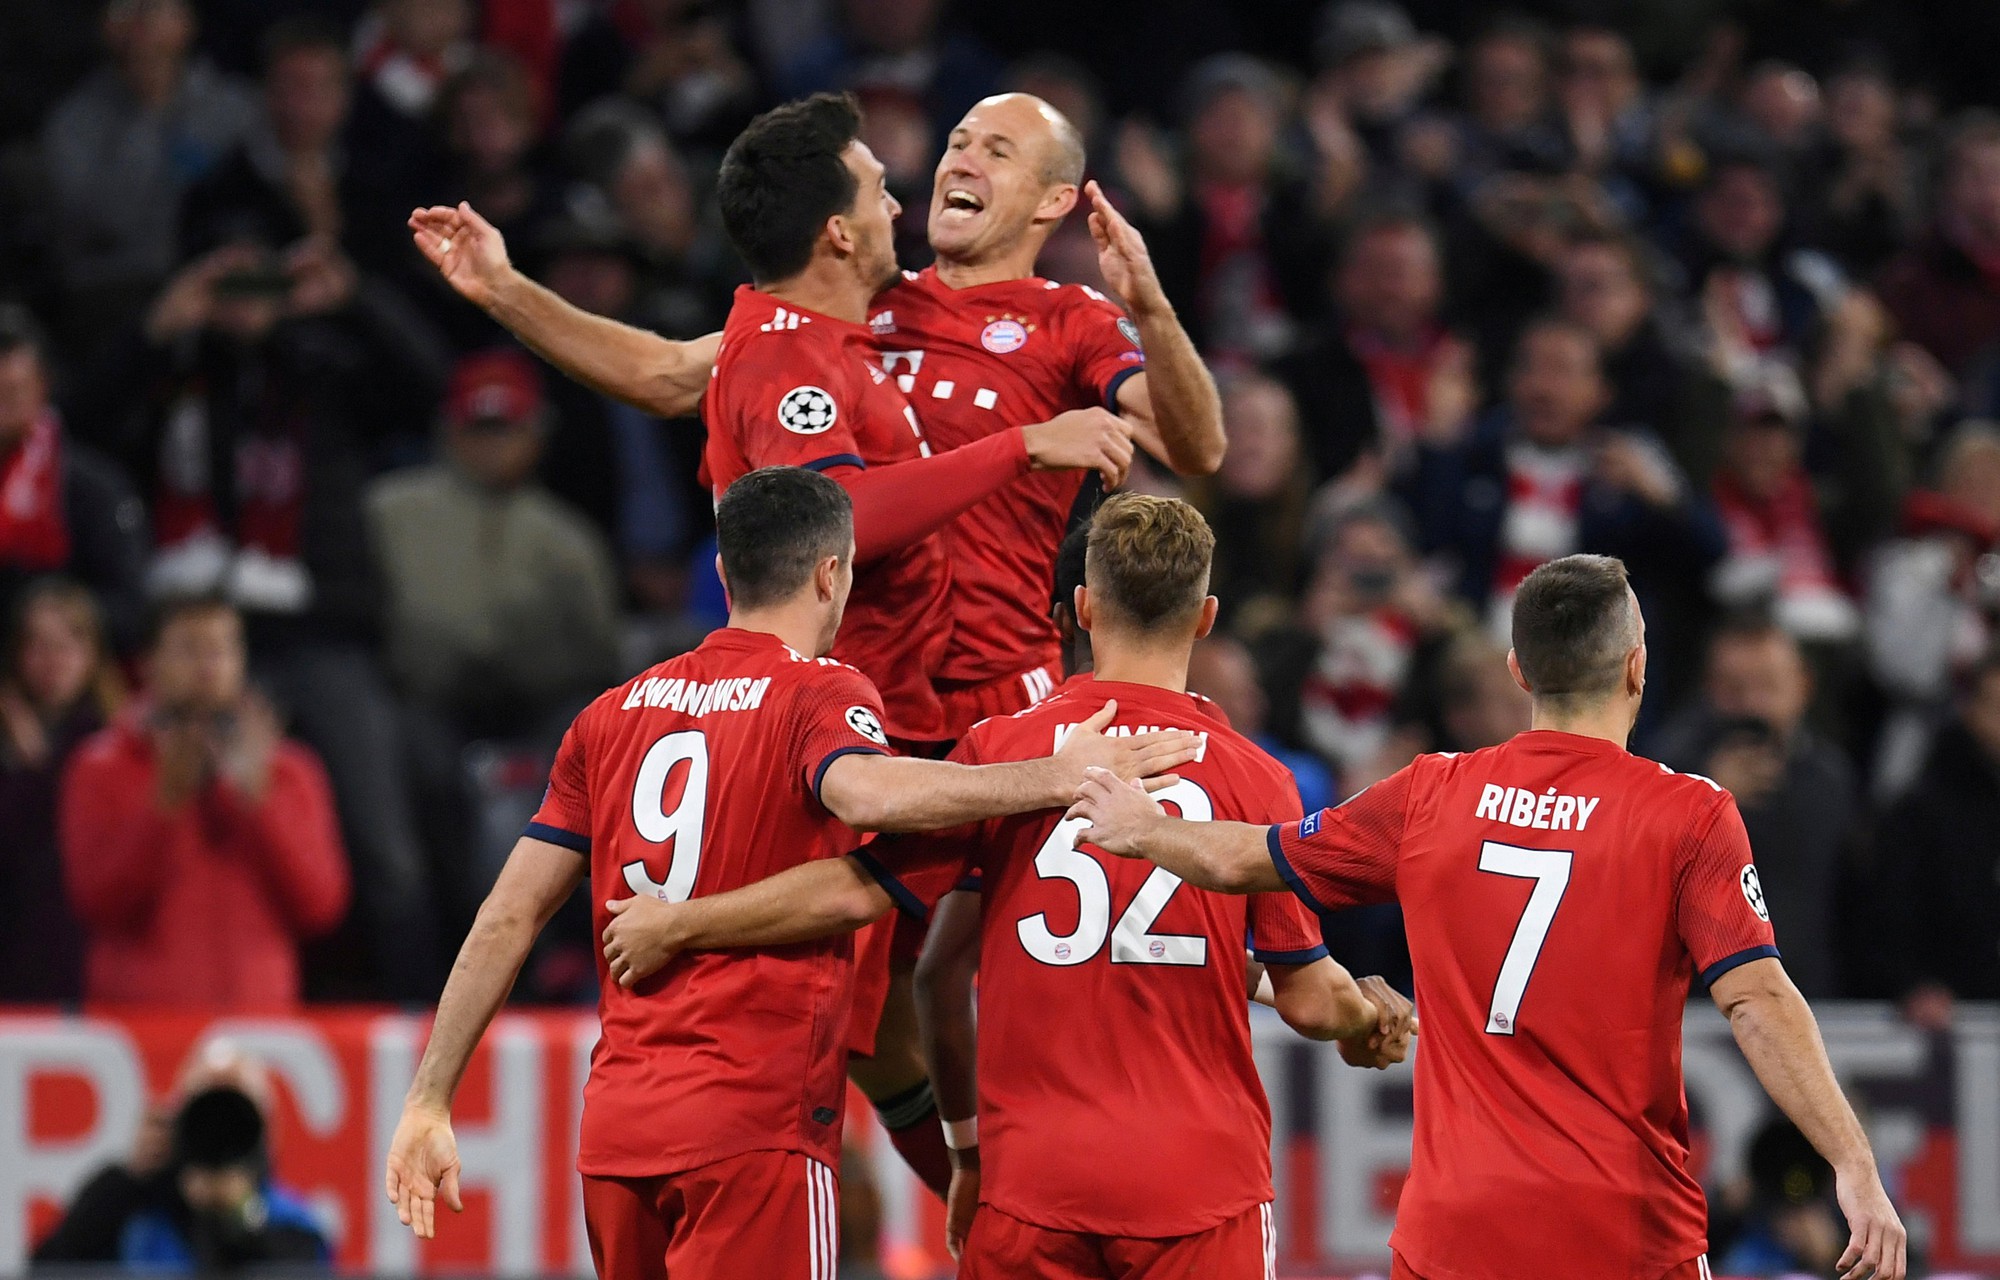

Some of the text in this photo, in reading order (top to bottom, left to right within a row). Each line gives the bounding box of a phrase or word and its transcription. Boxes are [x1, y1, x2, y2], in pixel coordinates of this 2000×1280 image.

[621, 729, 709, 904] 9
[1016, 776, 1214, 967] 32
[1474, 783, 1600, 831] RIBÉRY
[1476, 840, 1574, 1037] 7
